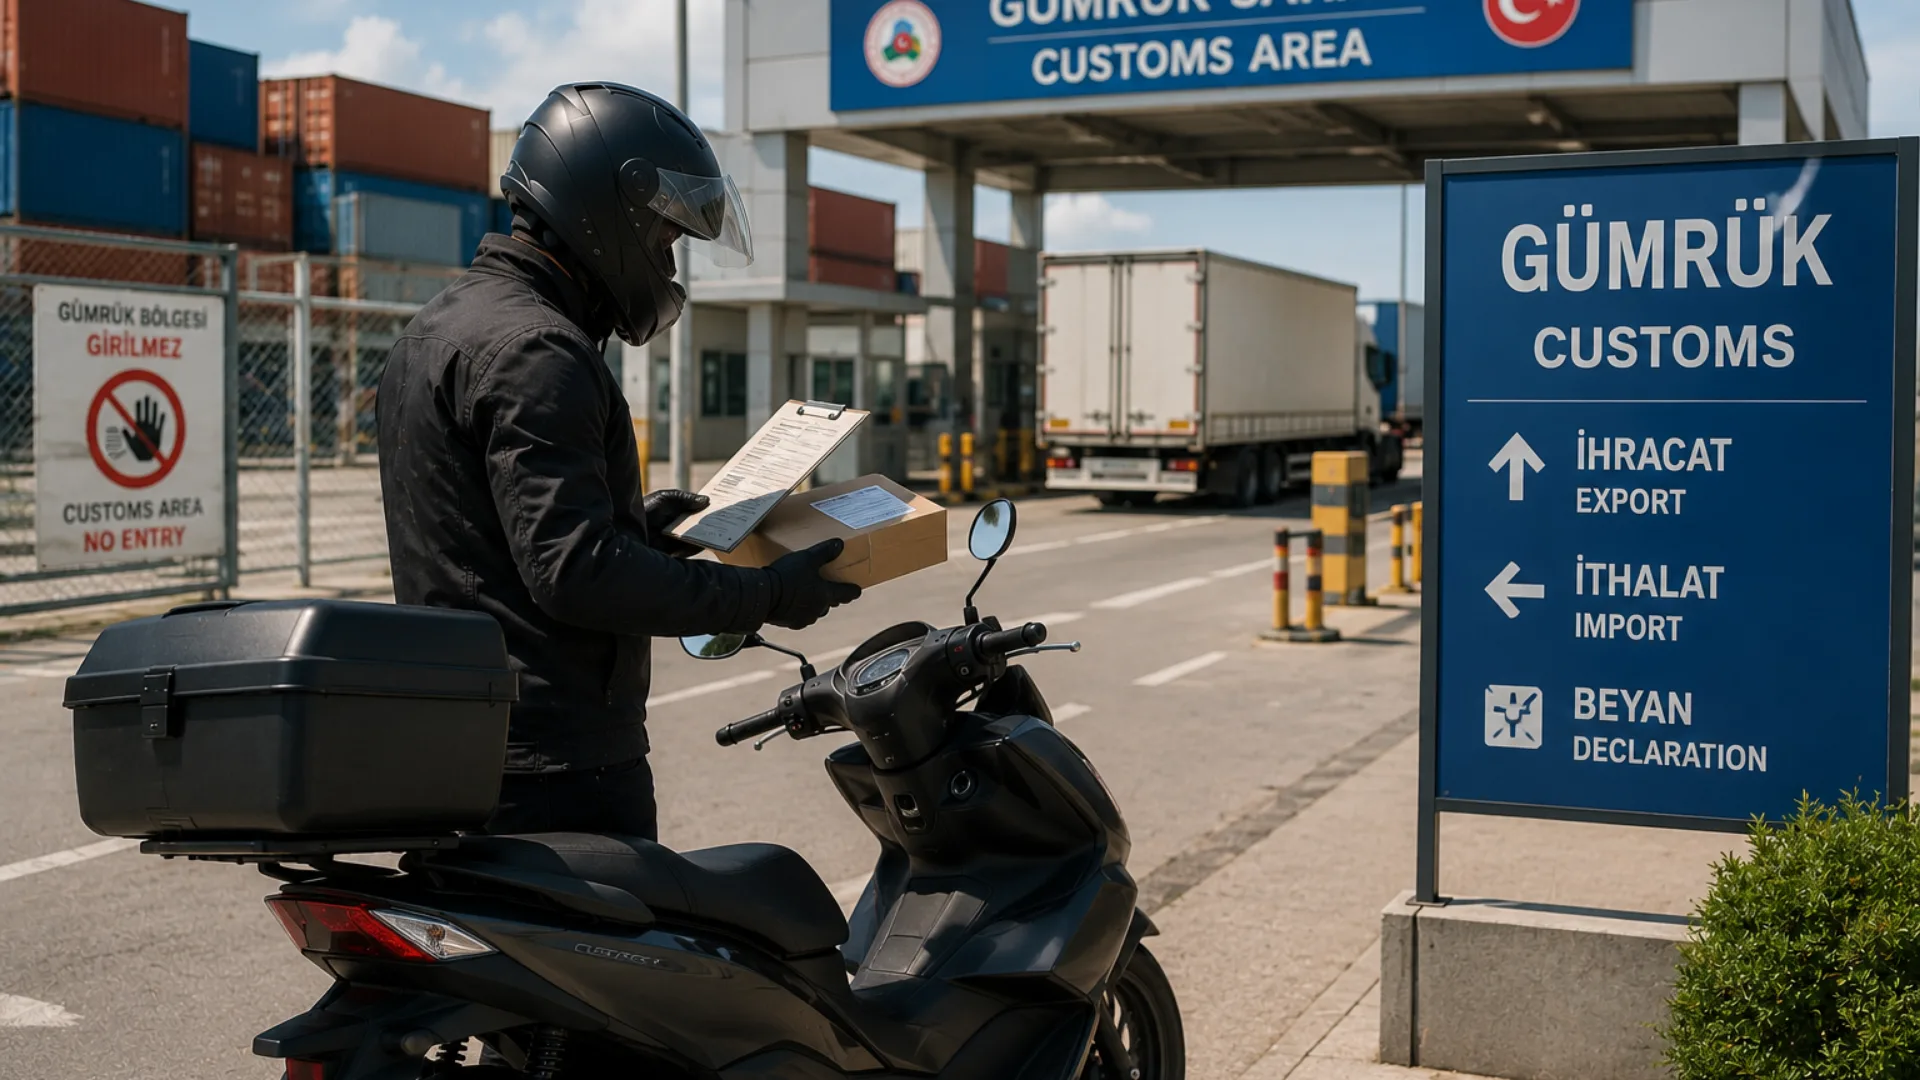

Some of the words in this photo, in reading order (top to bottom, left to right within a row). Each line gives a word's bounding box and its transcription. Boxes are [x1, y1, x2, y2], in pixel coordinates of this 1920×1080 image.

[1031, 38, 1233, 86] CUSTOMS
[1248, 28, 1372, 73] AREA
[1502, 198, 1833, 292] GÜMRÜK
[58, 299, 135, 325] GÜMRÜK
[139, 304, 208, 330] BÖLGESİ
[87, 331, 182, 359] GİRİLMEZ
[1534, 324, 1795, 369] CUSTOMS
[1577, 429, 1732, 471] İHRACAT
[63, 501, 154, 525] CUSTOMS
[158, 498, 205, 519] AREA
[1576, 488, 1687, 515] EXPORT
[83, 530, 115, 553] NO
[121, 526, 187, 550] ENTRY
[1576, 554, 1725, 600] İTHALAT
[1575, 613, 1683, 641] IMPORT
[1574, 687, 1692, 725] BEYAN
[1573, 736, 1767, 772] DECLARATION
